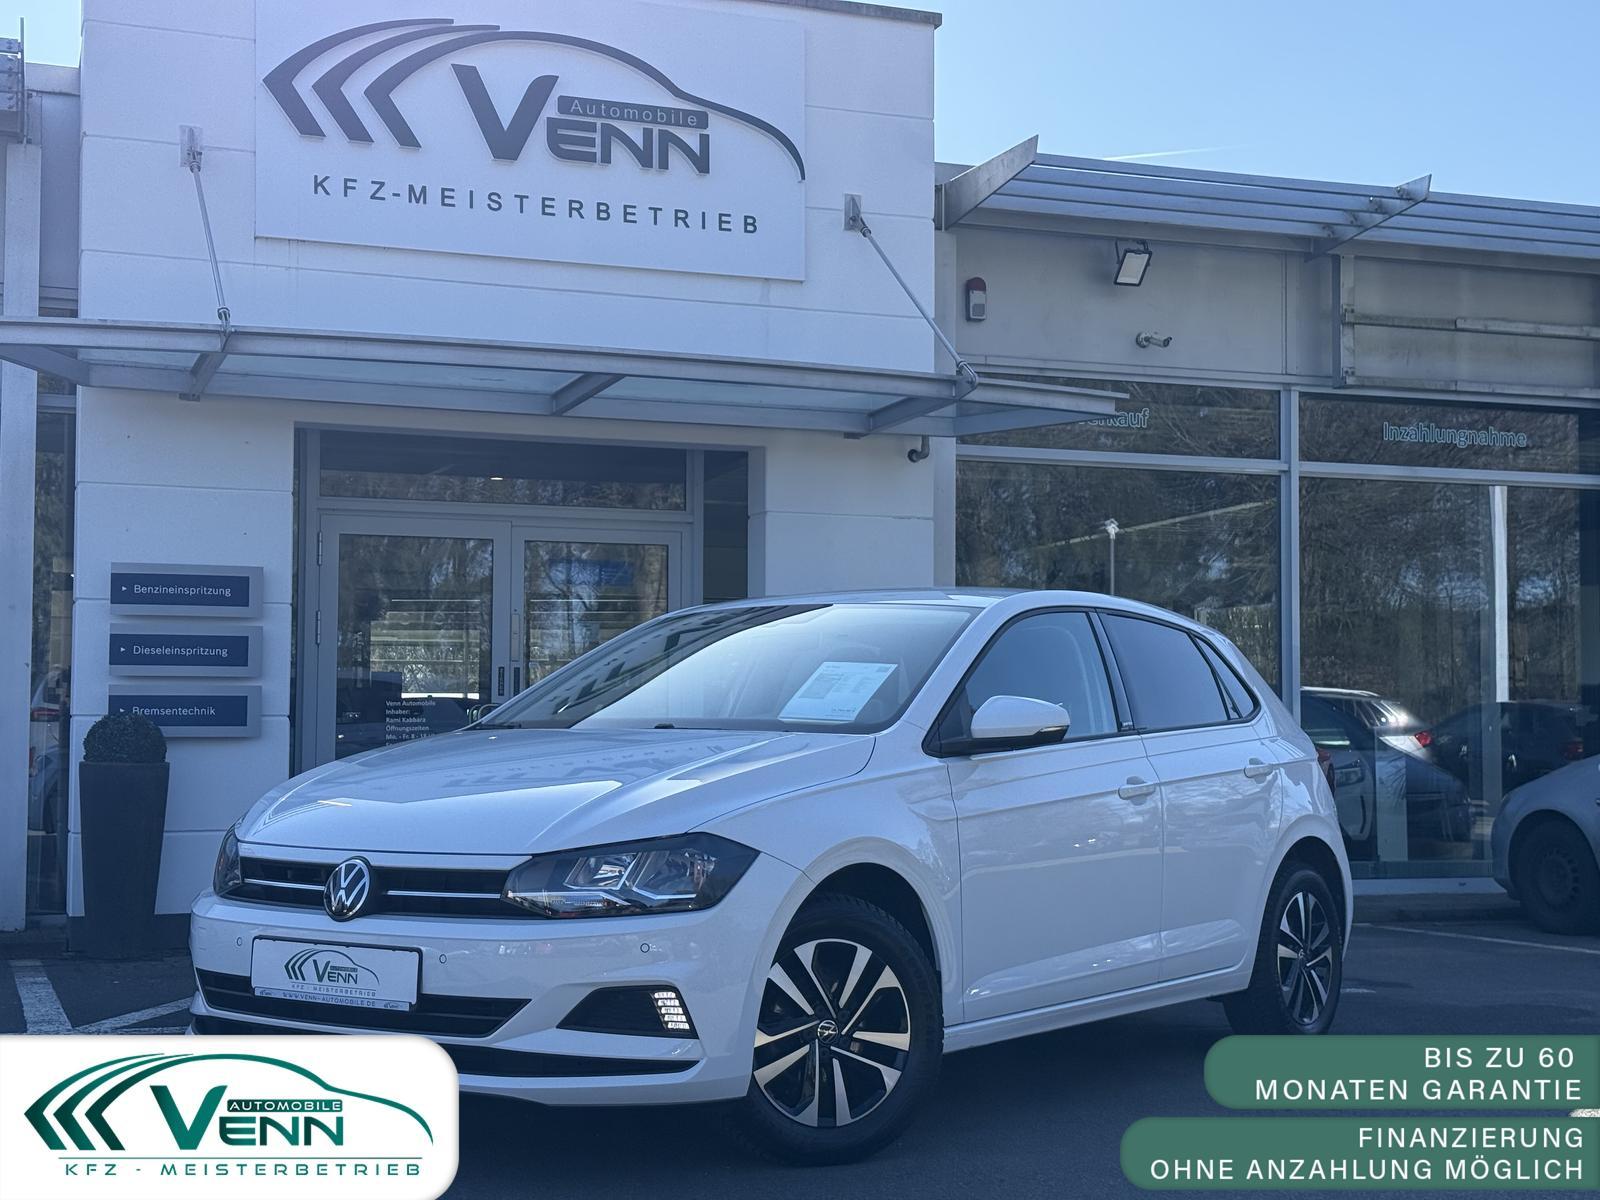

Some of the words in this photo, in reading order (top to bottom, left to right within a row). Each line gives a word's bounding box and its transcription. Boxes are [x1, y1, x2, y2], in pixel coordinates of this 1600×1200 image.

[451, 63, 710, 175] VENN
[570, 99, 698, 127] Automobile
[313, 174, 759, 234] KFZ-MEISTERBETRIEB
[1383, 421, 1528, 448] Inzahlungnahme
[134, 584, 232, 597] Benzineinspritzung
[133, 645, 229, 657] Dieseleinspritzung
[132, 706, 216, 716] Bremsentechnik
[312, 959, 358, 985] VENN
